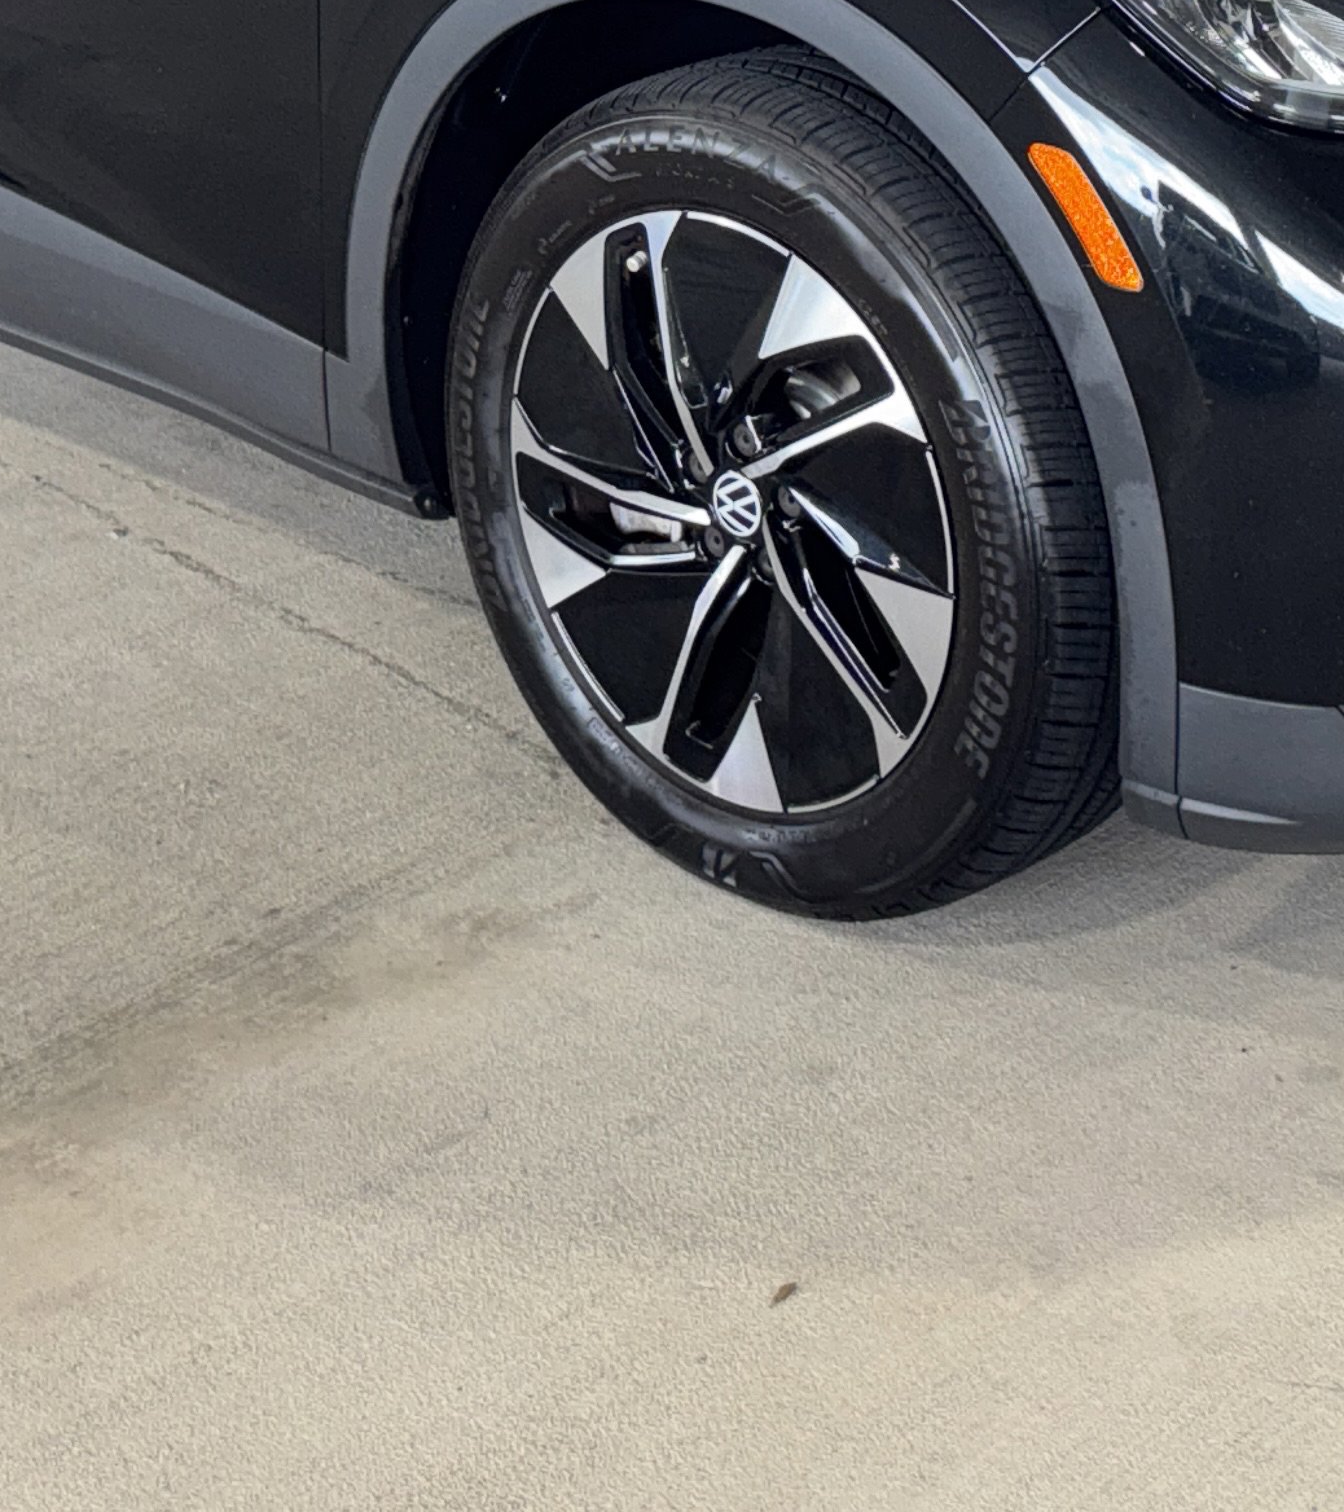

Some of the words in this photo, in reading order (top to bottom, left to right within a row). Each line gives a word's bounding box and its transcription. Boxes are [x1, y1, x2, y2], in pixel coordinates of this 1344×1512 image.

[615, 125, 778, 186] ALENZA
[713, 470, 762, 537] VW
[937, 398, 1019, 781] BRIDGESTONE
